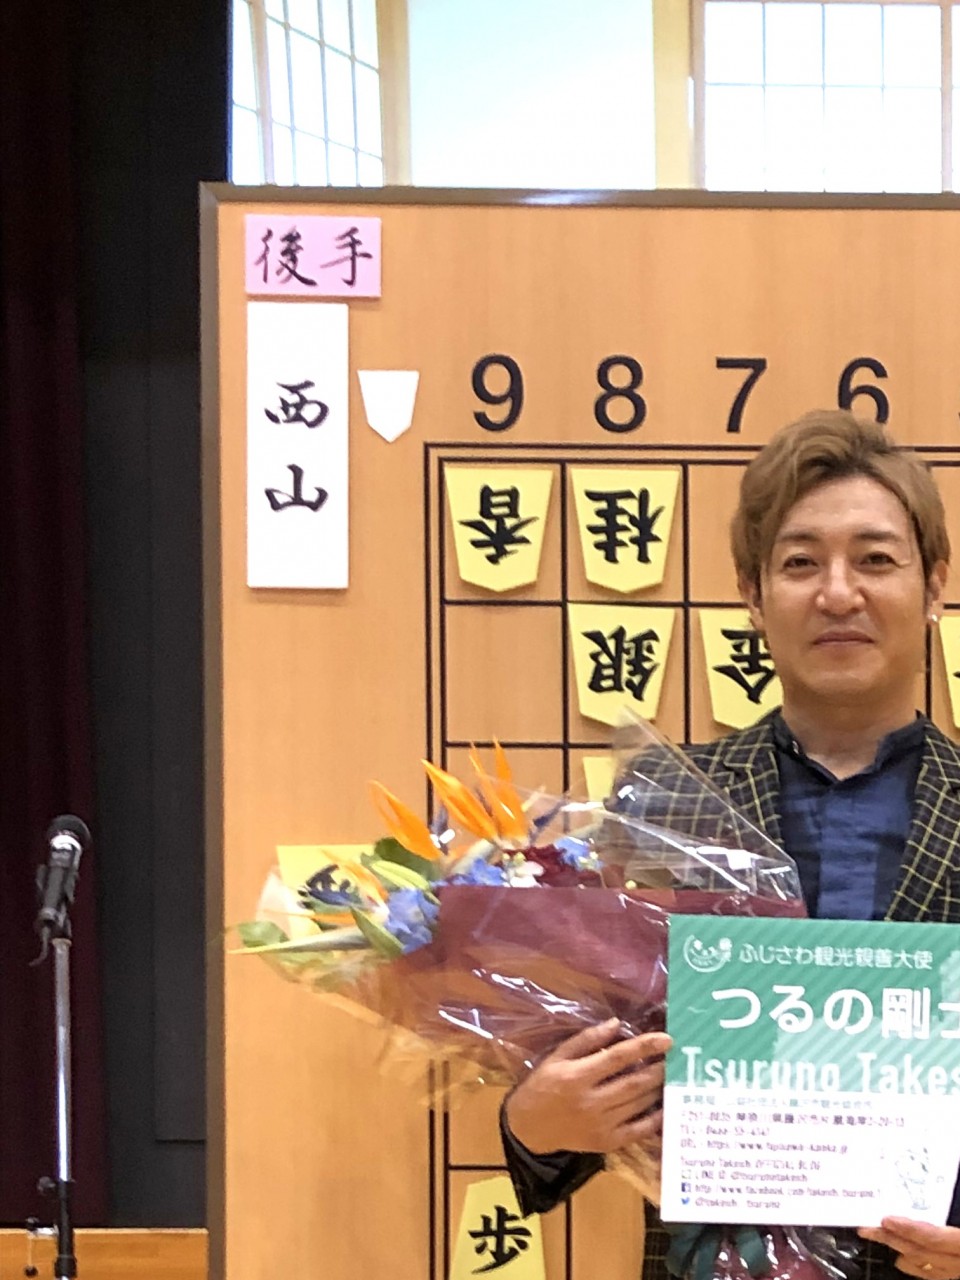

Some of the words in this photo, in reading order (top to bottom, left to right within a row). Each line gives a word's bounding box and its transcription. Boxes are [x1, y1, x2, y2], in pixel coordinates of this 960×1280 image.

[255, 227, 374, 287] 後手
[472, 355, 523, 432] 9
[594, 356, 646, 433] 8
[716, 358, 766, 433] 7
[837, 358, 889, 425] 6
[265, 381, 328, 511] 西山
[460, 486, 533, 564] 香
[585, 489, 662, 563] 桂
[583, 626, 659, 701] 銀
[681, 1046, 840, 1091] Tsuruno
[469, 1206, 531, 1273] 歩
